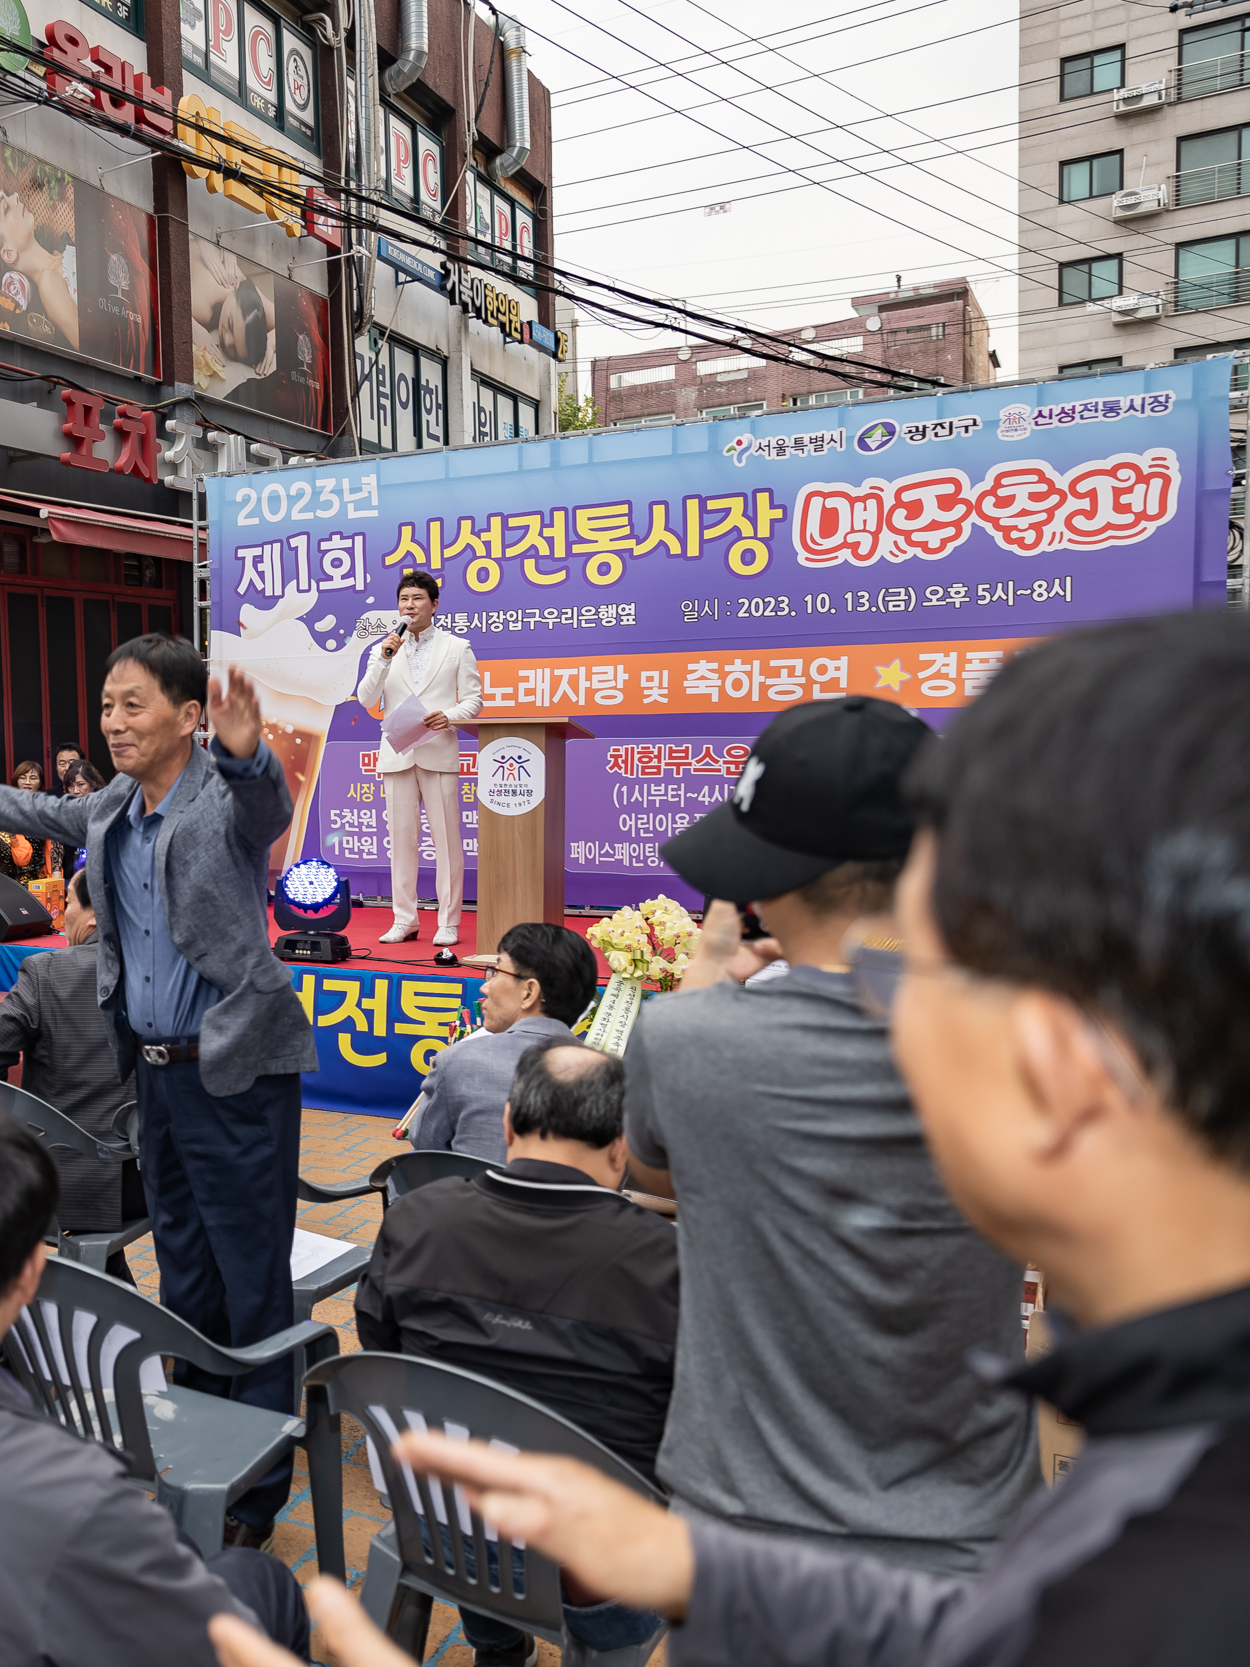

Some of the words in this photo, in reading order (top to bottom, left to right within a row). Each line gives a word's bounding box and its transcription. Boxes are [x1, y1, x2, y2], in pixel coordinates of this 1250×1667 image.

[116, 3, 129, 20] 3F
[292, 77, 307, 102] PC
[250, 92, 265, 112] CAFE
[267, 103, 277, 119] 3F
[98, 297, 120, 316] Olive
[121, 306, 142, 324] Aroma
[447, 260, 522, 342] 거북이한의원
[556, 330, 569, 362] 2F
[290, 370, 306, 385] Olive
[1031, 392, 1173, 428] 신성전통시장
[59, 388, 163, 485] 포차
[903, 416, 980, 443] 광진구
[755, 429, 844, 458] 서울특별시
[236, 473, 379, 527] 2023년
[235, 532, 367, 598] 제1회
[383, 491, 785, 594] 신성전통시장
[796, 450, 1180, 566] 맥주축제
[680, 598, 719, 624] 일시
[736, 596, 797, 619] 2023.
[803, 594, 837, 615] 10.
[843, 587, 917, 614] 13.(금)
[922, 583, 970, 609] 오후
[976, 576, 1073, 607] 5시~8시
[483, 665, 630, 708] 노래자랑
[640, 669, 669, 704] 및
[683, 655, 850, 703] 축하공연
[347, 782, 376, 803] 시장
[487, 788, 534, 797] 신성전통시장
[489, 798, 511, 809] SINCE
[513, 799, 532, 808] 1972
[330, 808, 378, 832] 5천원
[332, 835, 378, 860] 1만원
